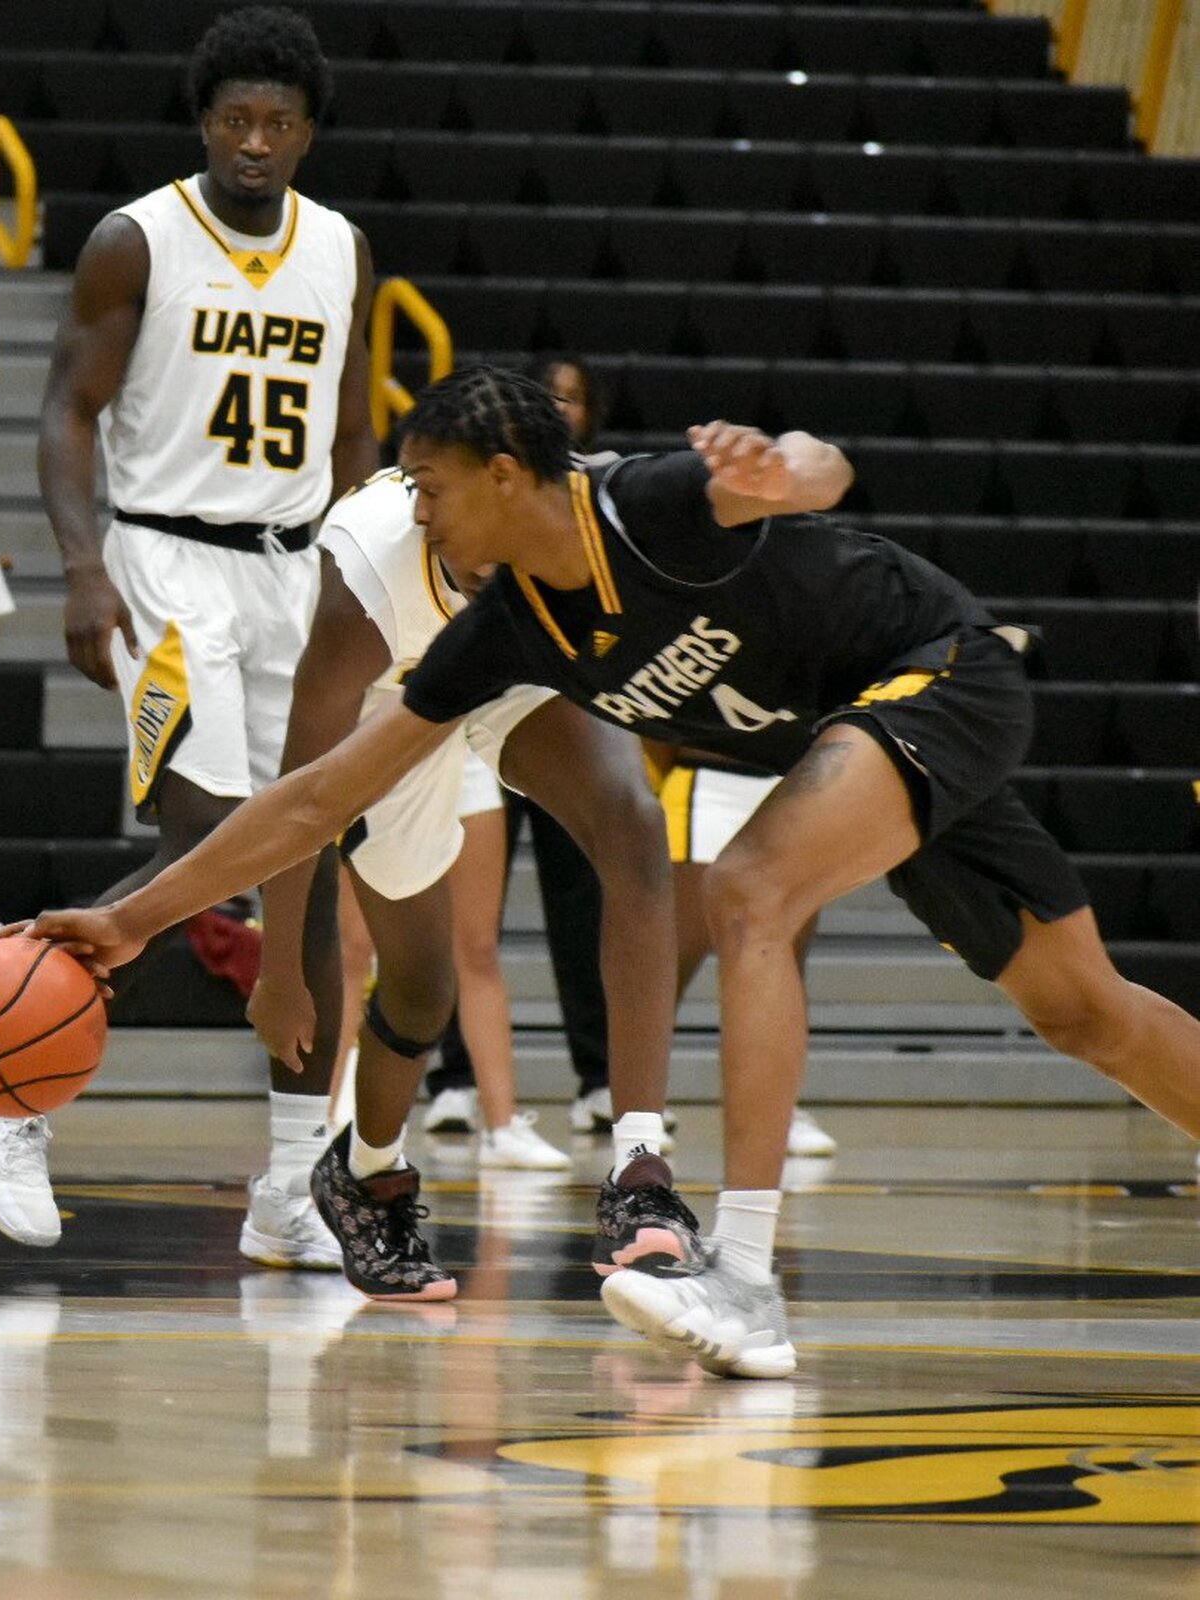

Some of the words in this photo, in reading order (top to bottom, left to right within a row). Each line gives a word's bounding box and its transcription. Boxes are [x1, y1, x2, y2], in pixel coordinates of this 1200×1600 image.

[192, 308, 326, 365] UAPB
[206, 370, 308, 473] 45
[709, 683, 798, 732] 4
